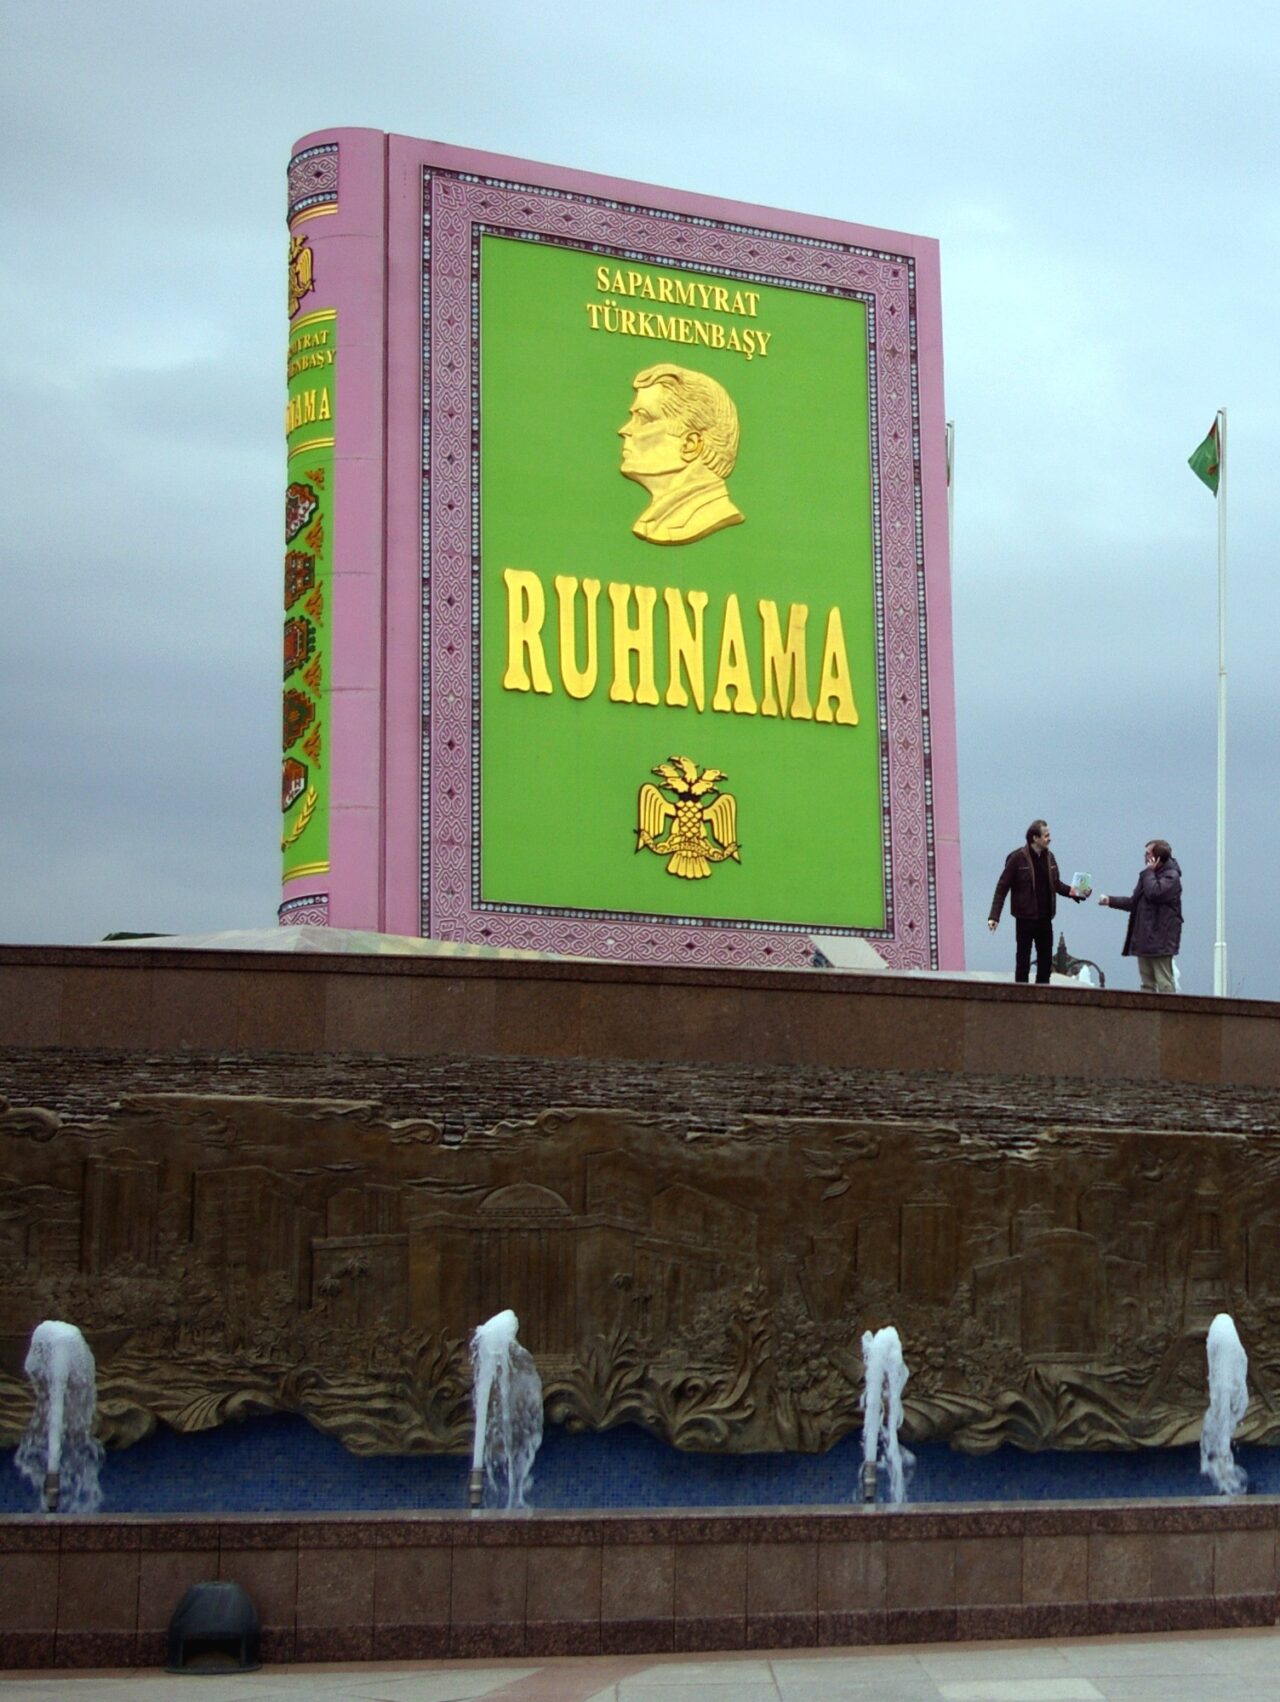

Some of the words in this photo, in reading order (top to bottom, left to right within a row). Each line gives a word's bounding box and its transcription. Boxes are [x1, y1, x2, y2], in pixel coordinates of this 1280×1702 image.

[597, 266, 760, 317] SAPARMYRAT
[587, 299, 771, 360] TÜRKMENBAŞY
[503, 567, 859, 726] RUHNAMA
